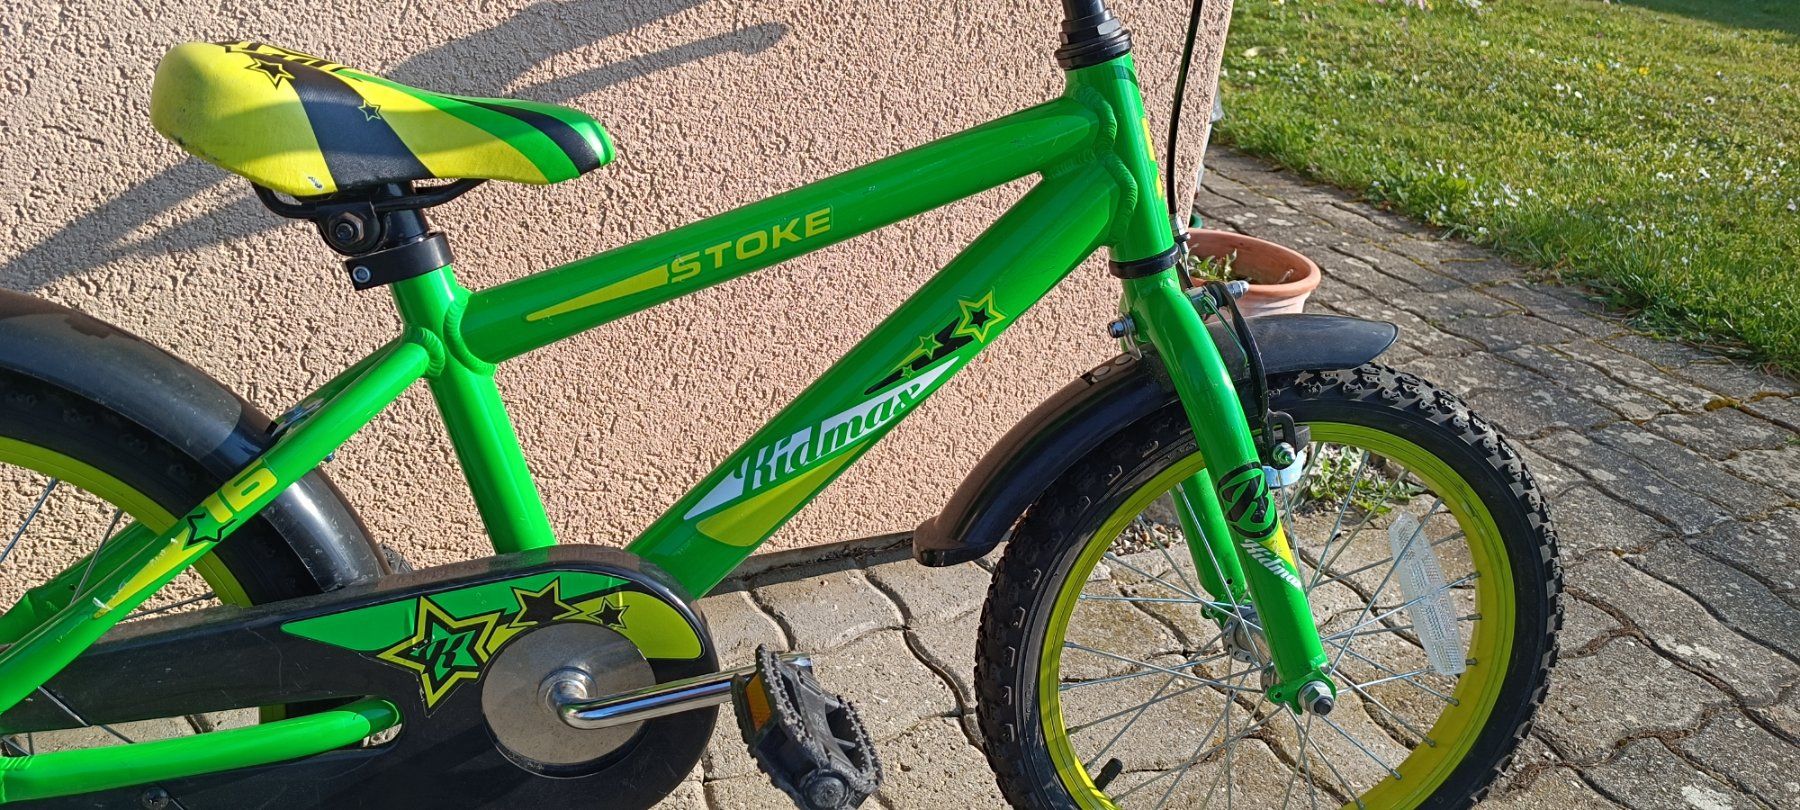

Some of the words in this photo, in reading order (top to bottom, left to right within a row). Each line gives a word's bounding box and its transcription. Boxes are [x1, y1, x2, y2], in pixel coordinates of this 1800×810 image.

[671, 207, 831, 284] STOKE
[734, 383, 921, 497] Kidmax
[201, 457, 278, 523] 16
[1241, 539, 1303, 590] Kidma
